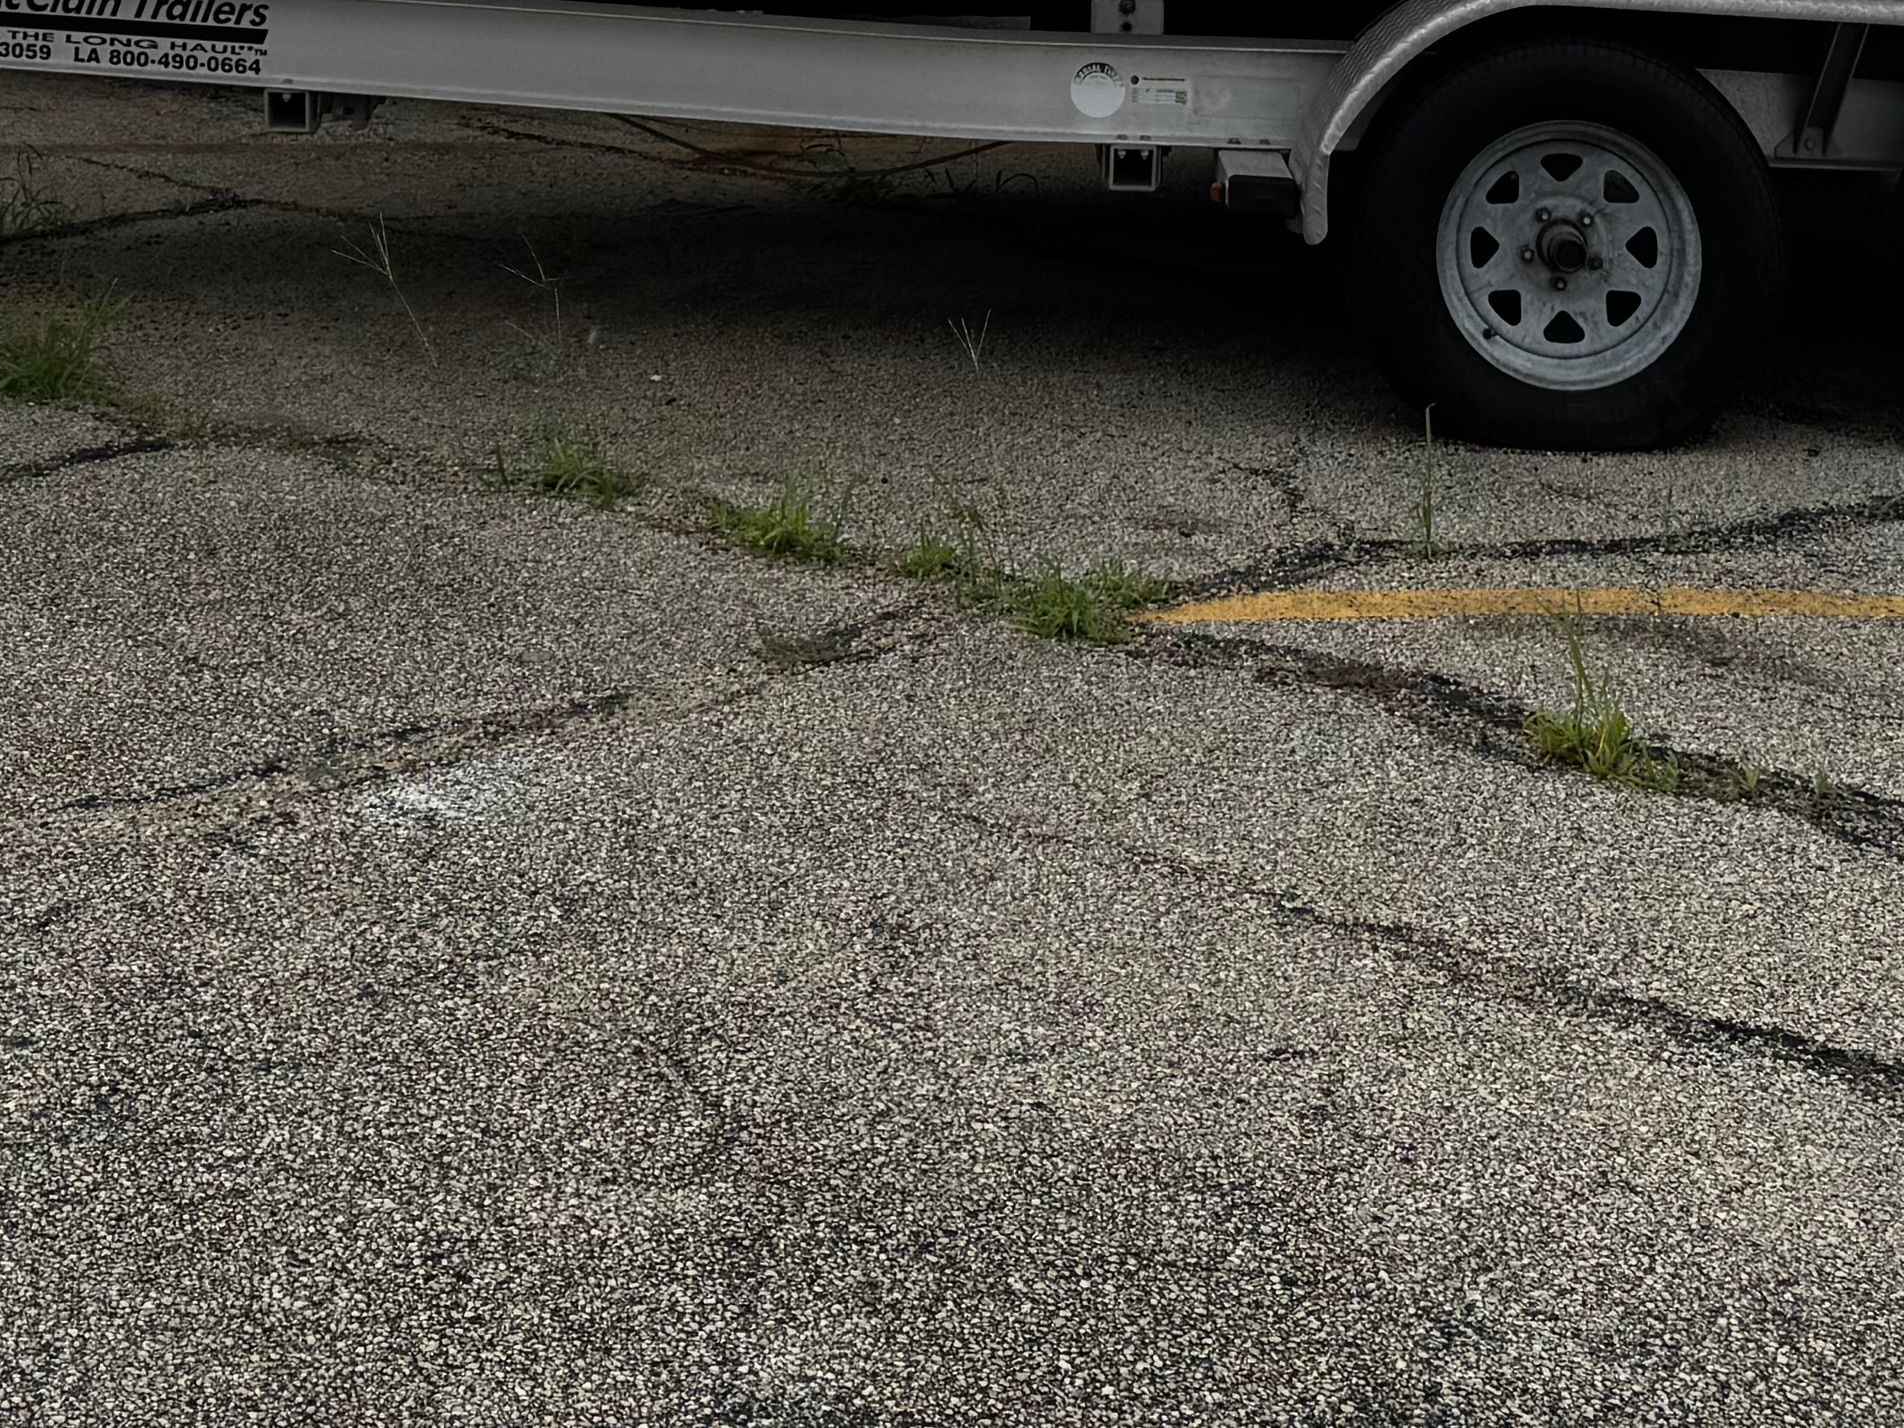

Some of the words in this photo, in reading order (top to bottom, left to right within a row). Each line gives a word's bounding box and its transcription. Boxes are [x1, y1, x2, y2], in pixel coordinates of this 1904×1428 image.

[8, 29, 55, 43] THE
[65, 34, 159, 50] LONG
[73, 46, 101, 64] LA
[108, 49, 262, 75] 800-490-0664
